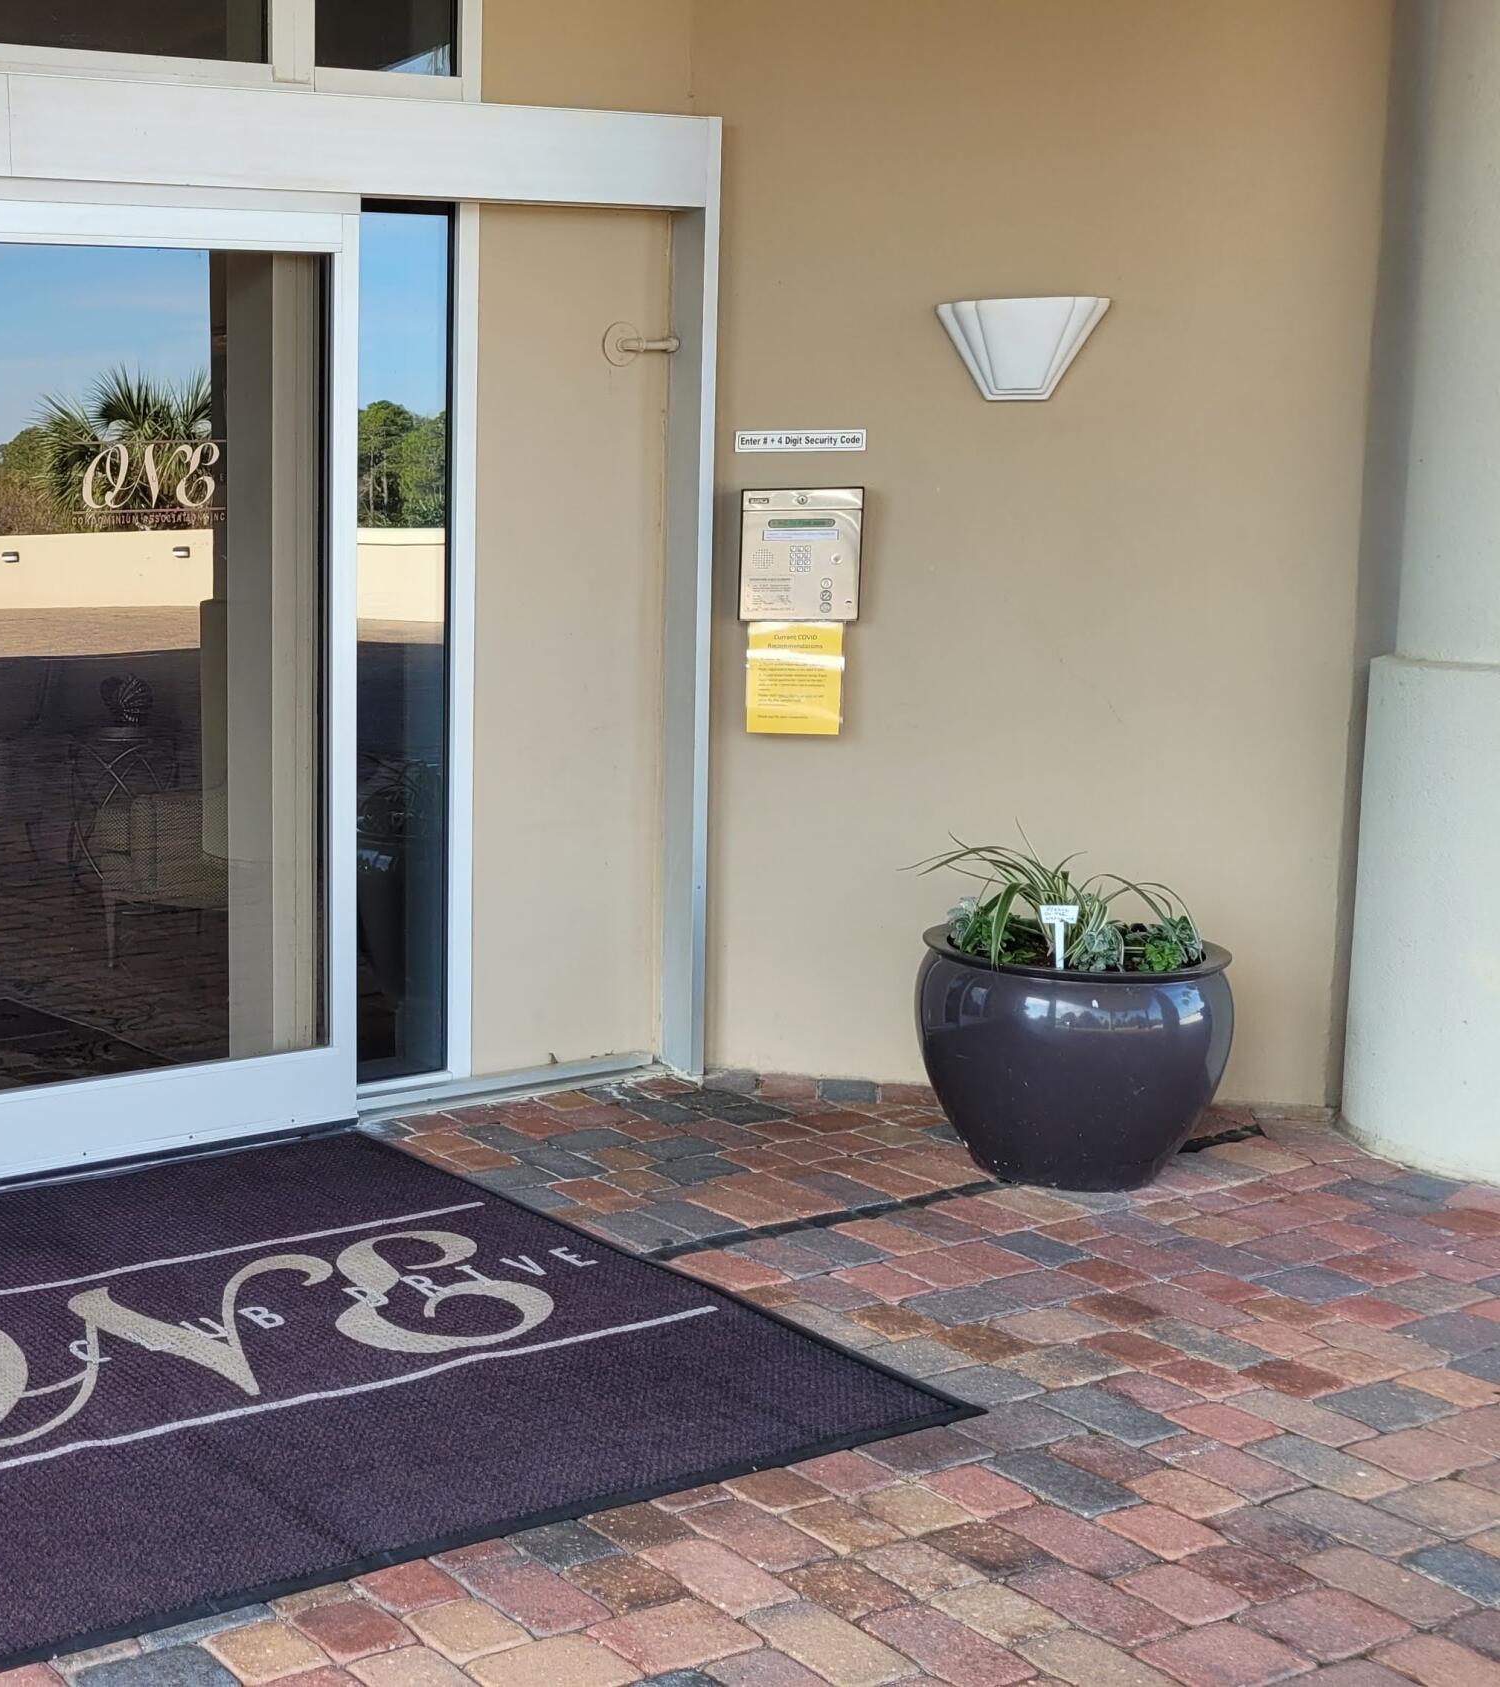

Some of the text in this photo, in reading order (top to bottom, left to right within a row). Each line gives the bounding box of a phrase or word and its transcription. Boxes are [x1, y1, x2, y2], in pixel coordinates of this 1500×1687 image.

[740, 436, 760, 446] Enter
[762, 436, 768, 445] #
[777, 436, 783, 444] 4
[785, 435, 802, 447] Digit
[804, 435, 838, 447] Security
[840, 434, 861, 444] Code
[82, 442, 220, 509] ONE
[68, 1305, 287, 1365] CLUB
[341, 1246, 599, 1309] DRIVE
